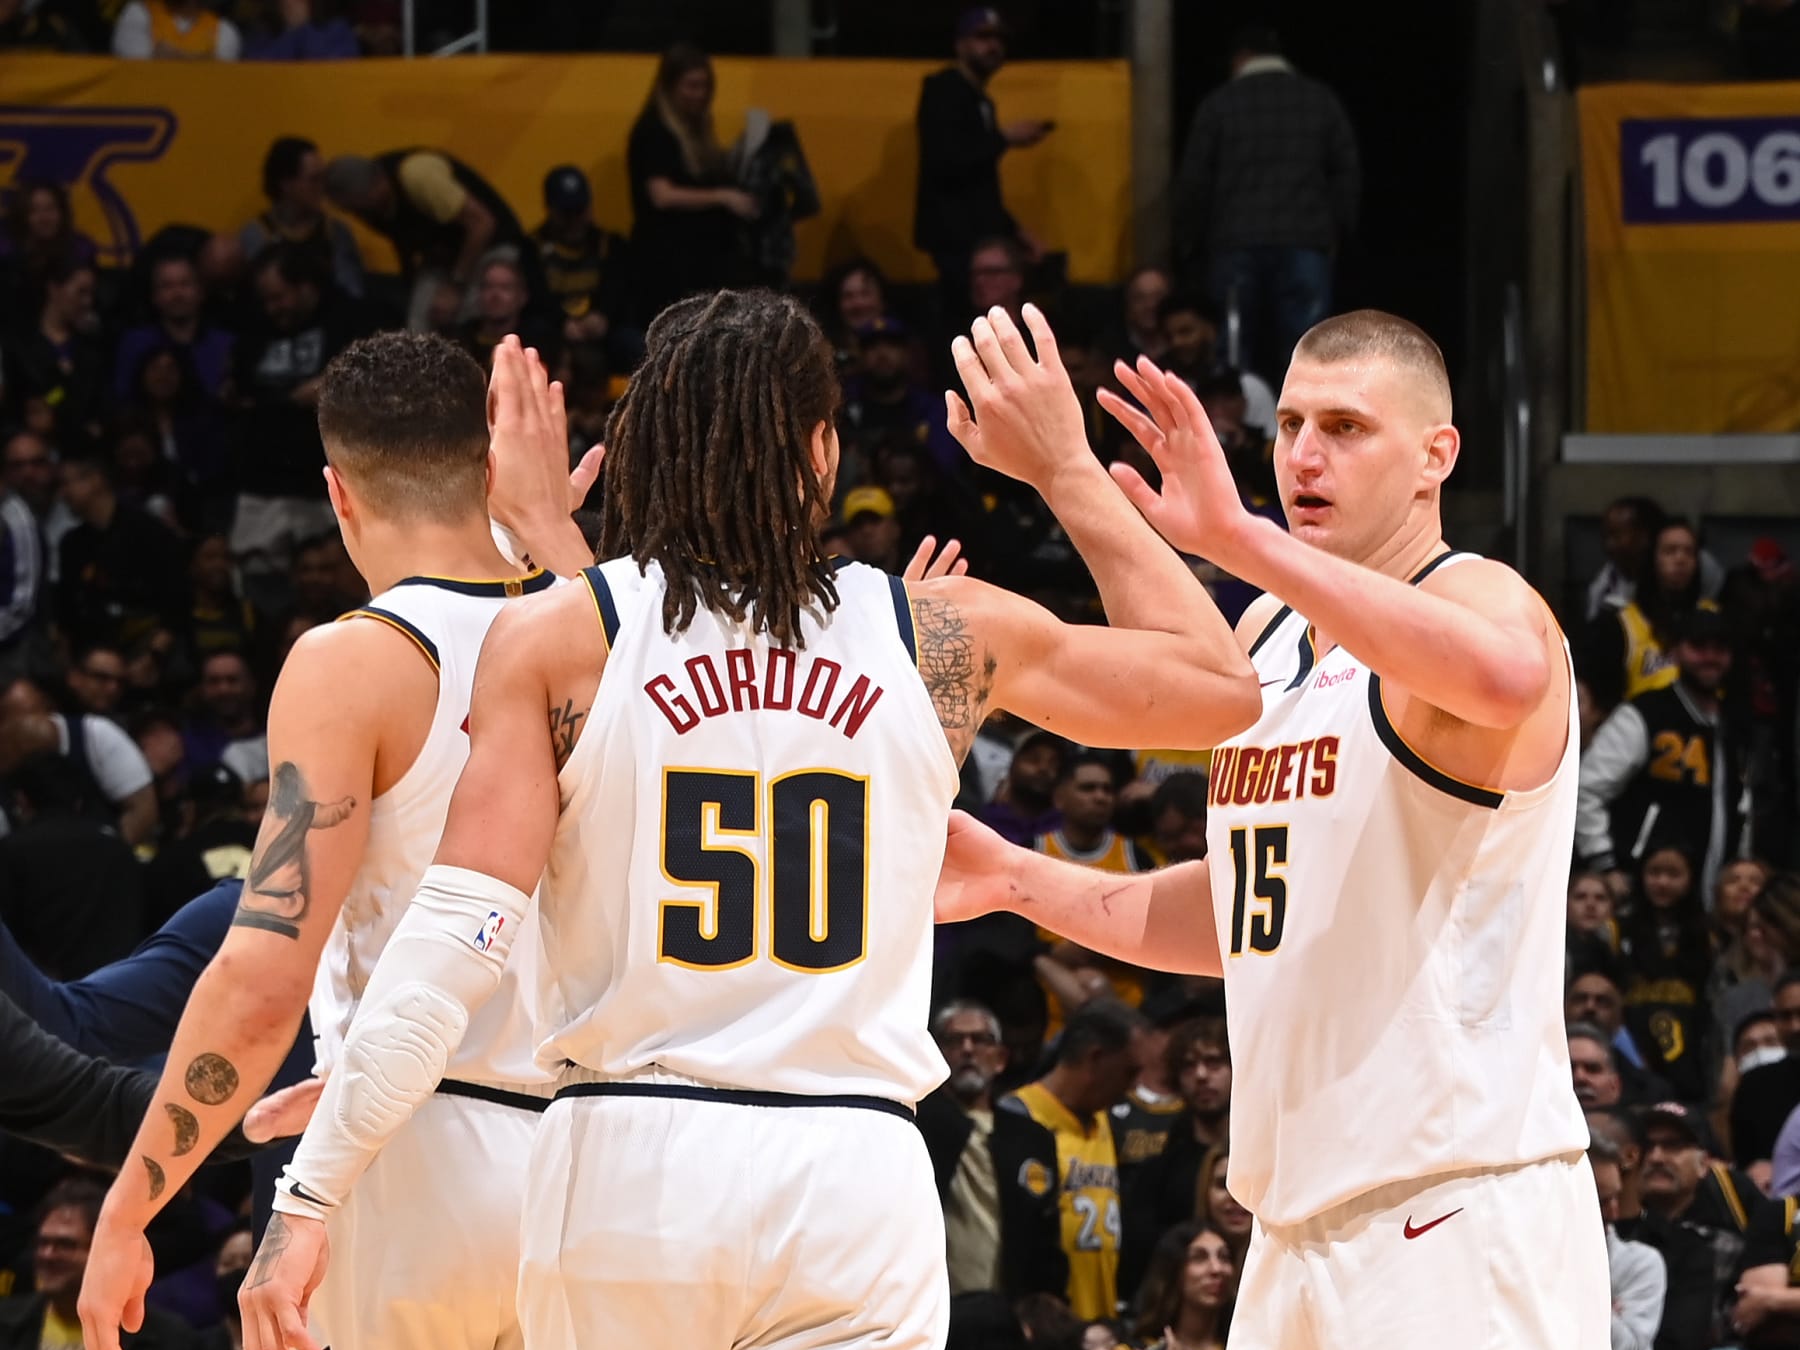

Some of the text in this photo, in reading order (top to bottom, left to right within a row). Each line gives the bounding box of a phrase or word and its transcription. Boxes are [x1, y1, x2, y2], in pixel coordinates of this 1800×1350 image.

[1640, 132, 1800, 209] 106
[644, 647, 884, 739] GORDON
[1208, 737, 1341, 808] NUGGETS
[1651, 732, 1709, 784] 24
[657, 766, 871, 975] 50
[1228, 822, 1290, 959] 15
[1073, 1196, 1122, 1251] 24
